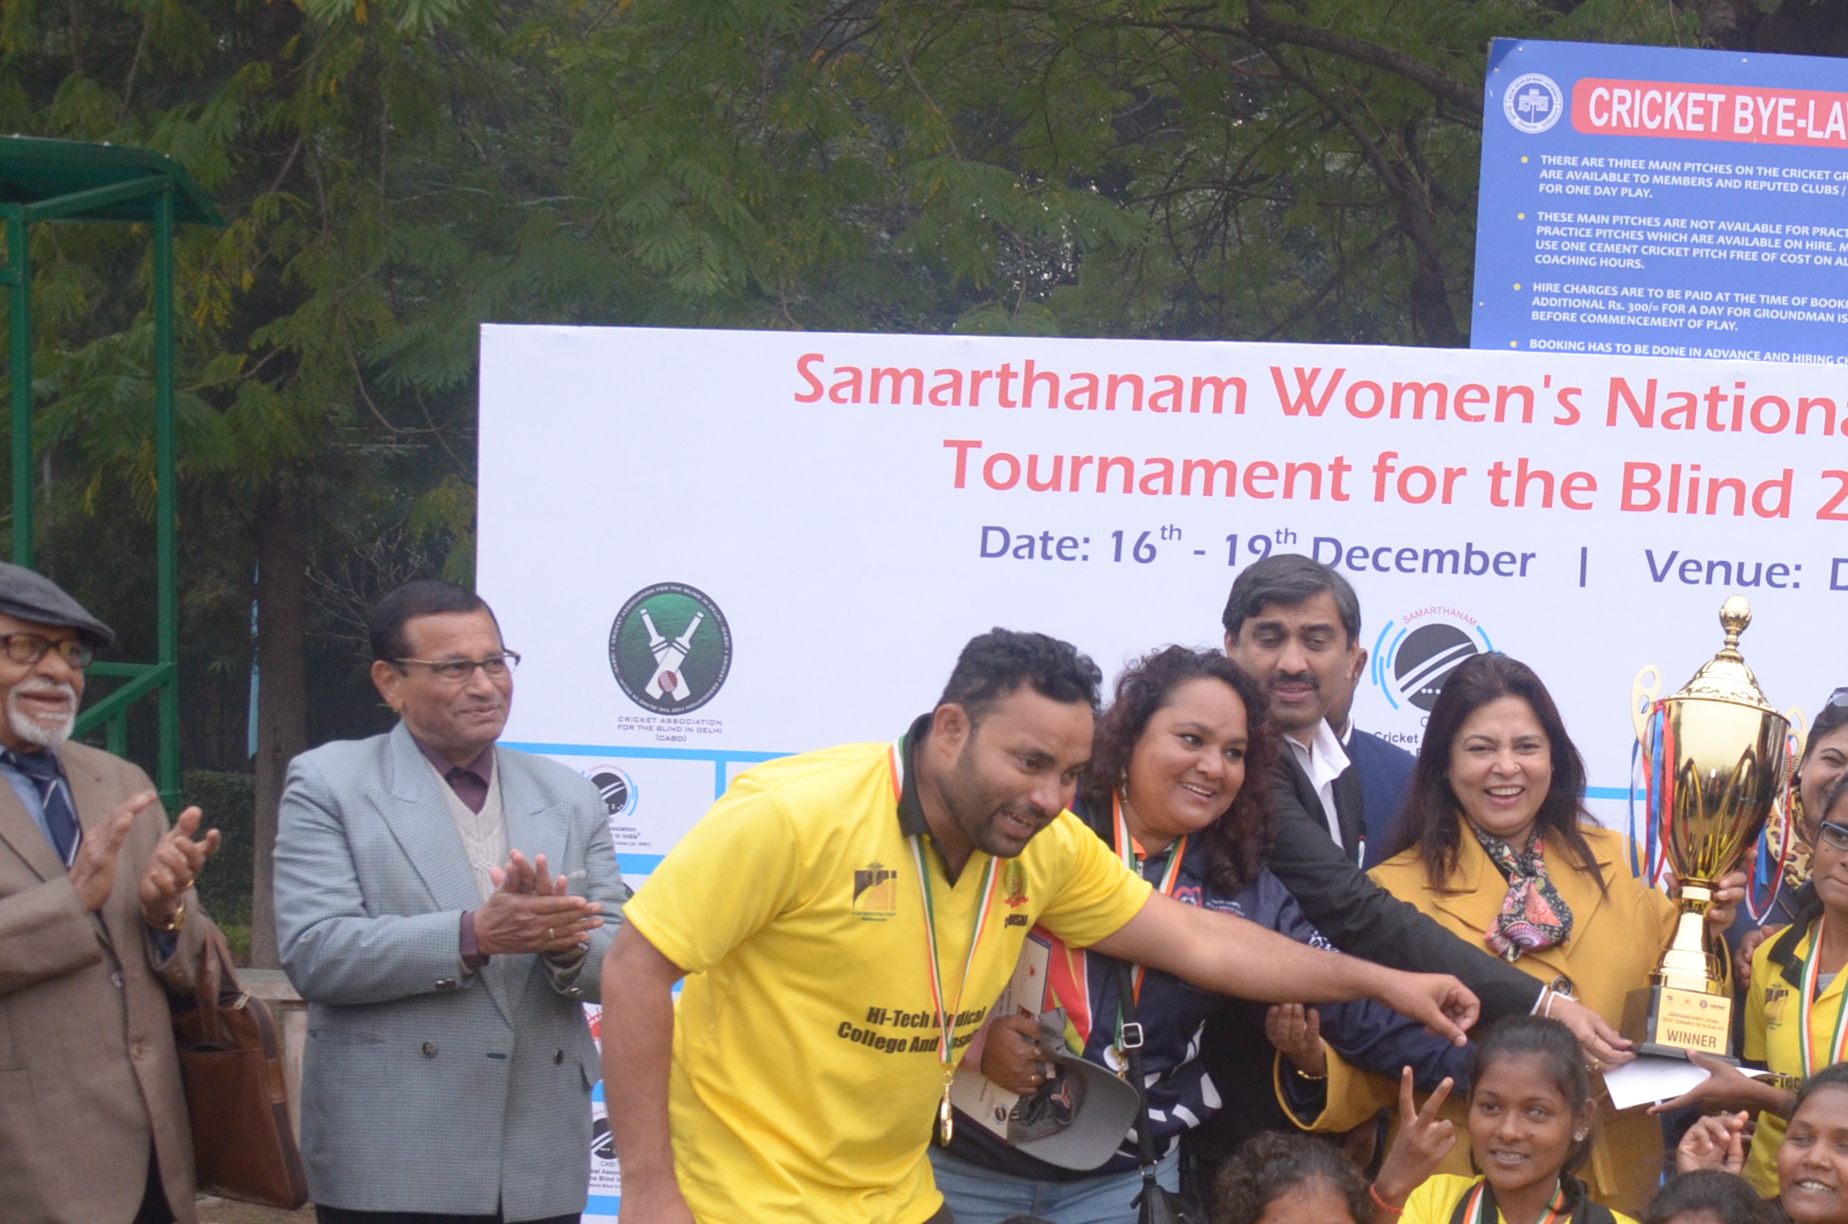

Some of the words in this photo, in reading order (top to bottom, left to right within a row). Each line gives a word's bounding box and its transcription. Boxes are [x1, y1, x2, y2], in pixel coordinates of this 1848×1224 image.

[1589, 87, 1726, 132] CRICKET
[1541, 155, 1578, 165] THERE
[1581, 157, 1604, 166] ARE
[1608, 158, 1644, 169] THREE
[1648, 160, 1680, 171] MAIN
[1684, 162, 1732, 174] PITCHES
[1735, 165, 1753, 175] ON
[1756, 166, 1778, 176] THE
[1782, 168, 1830, 179] CRICKET
[1539, 183, 1562, 193] FOR
[1565, 184, 1590, 195] ONE
[1593, 185, 1618, 196] DAY
[1620, 186, 1652, 198] PLAY.
[1540, 169, 1562, 179] ARE
[1565, 170, 1630, 182] AVAILABLE
[1634, 173, 1649, 183] TO
[1652, 174, 1712, 187] MEMBERS
[1715, 178, 1741, 188] AND
[1745, 180, 1798, 192] REPUTED
[1801, 183, 1839, 194] CLUBS
[1538, 212, 1573, 222] THESE
[1577, 213, 1609, 223] MAIN
[1612, 215, 1660, 226] PITCHES
[1663, 218, 1686, 228] ARE
[1690, 220, 1715, 229] NOT
[1718, 221, 1781, 233] AVAILABLE
[1785, 225, 1809, 235] FOR
[1536, 225, 1592, 237] PRACTICE
[1595, 228, 1644, 240] PITCHES
[1646, 231, 1687, 242] WHICH
[1690, 234, 1713, 243] ARE
[1716, 235, 1780, 248] AVAILABLE
[1784, 239, 1802, 249] ON
[1805, 240, 1835, 251] HIRE.
[1534, 254, 1596, 266] COACHING
[1599, 257, 1644, 269] HOURS.
[1535, 240, 1558, 249] USE
[1561, 241, 1586, 251] ONE
[1589, 242, 1638, 253] CEMENT
[1641, 245, 1689, 256] CRICKET
[1692, 248, 1726, 258] PITCH
[1730, 250, 1758, 260] FREE
[1761, 252, 1777, 261] OF
[1780, 253, 1810, 263] COST
[1814, 255, 1832, 265] ON
[1533, 282, 1560, 293] HIRE
[1563, 283, 1618, 296] CHARGES
[1620, 287, 1644, 297] ARE
[1647, 288, 1664, 298] TO
[1666, 289, 1681, 299] BE
[1684, 290, 1713, 300] PAID
[1715, 292, 1731, 302] AT
[1733, 292, 1756, 303] THE
[1759, 294, 1788, 305] TIME
[1791, 296, 1808, 306] OF
[1531, 310, 1576, 322] BEFORE
[1580, 313, 1685, 327] COMMENCEMENT
[1687, 318, 1704, 328] OF
[1706, 320, 1738, 330] PLAY.
[1532, 297, 1605, 309] ADDITIONAL
[1608, 300, 1624, 310] Rs.
[1662, 303, 1685, 313] FOR
[1700, 305, 1724, 315] DAY
[1727, 306, 1750, 317] FOR
[1753, 308, 1834, 322] GROUNDMAN
[1837, 314, 1848, 323] IS
[795, 353, 1247, 414] Samarthanam
[1270, 366, 1582, 426] Women's
[944, 440, 1352, 501] Tournament
[1373, 451, 1467, 504] for
[1488, 458, 1597, 510] the
[1621, 462, 1794, 518] Blind
[980, 526, 1090, 561] Date:
[1112, 524, 1181, 563] 16th
[1312, 537, 1536, 577] December
[1645, 550, 1801, 589] Venue:
[1402, 606, 1477, 627] SAMARTHANAM
[660, 718, 722, 726] ASSOCIATION
[656, 734, 686, 742] (CABD)
[866, 1007, 930, 1028] Hi-Tech
[838, 1021, 907, 1054] College
[1667, 1029, 1717, 1048] WINNER
